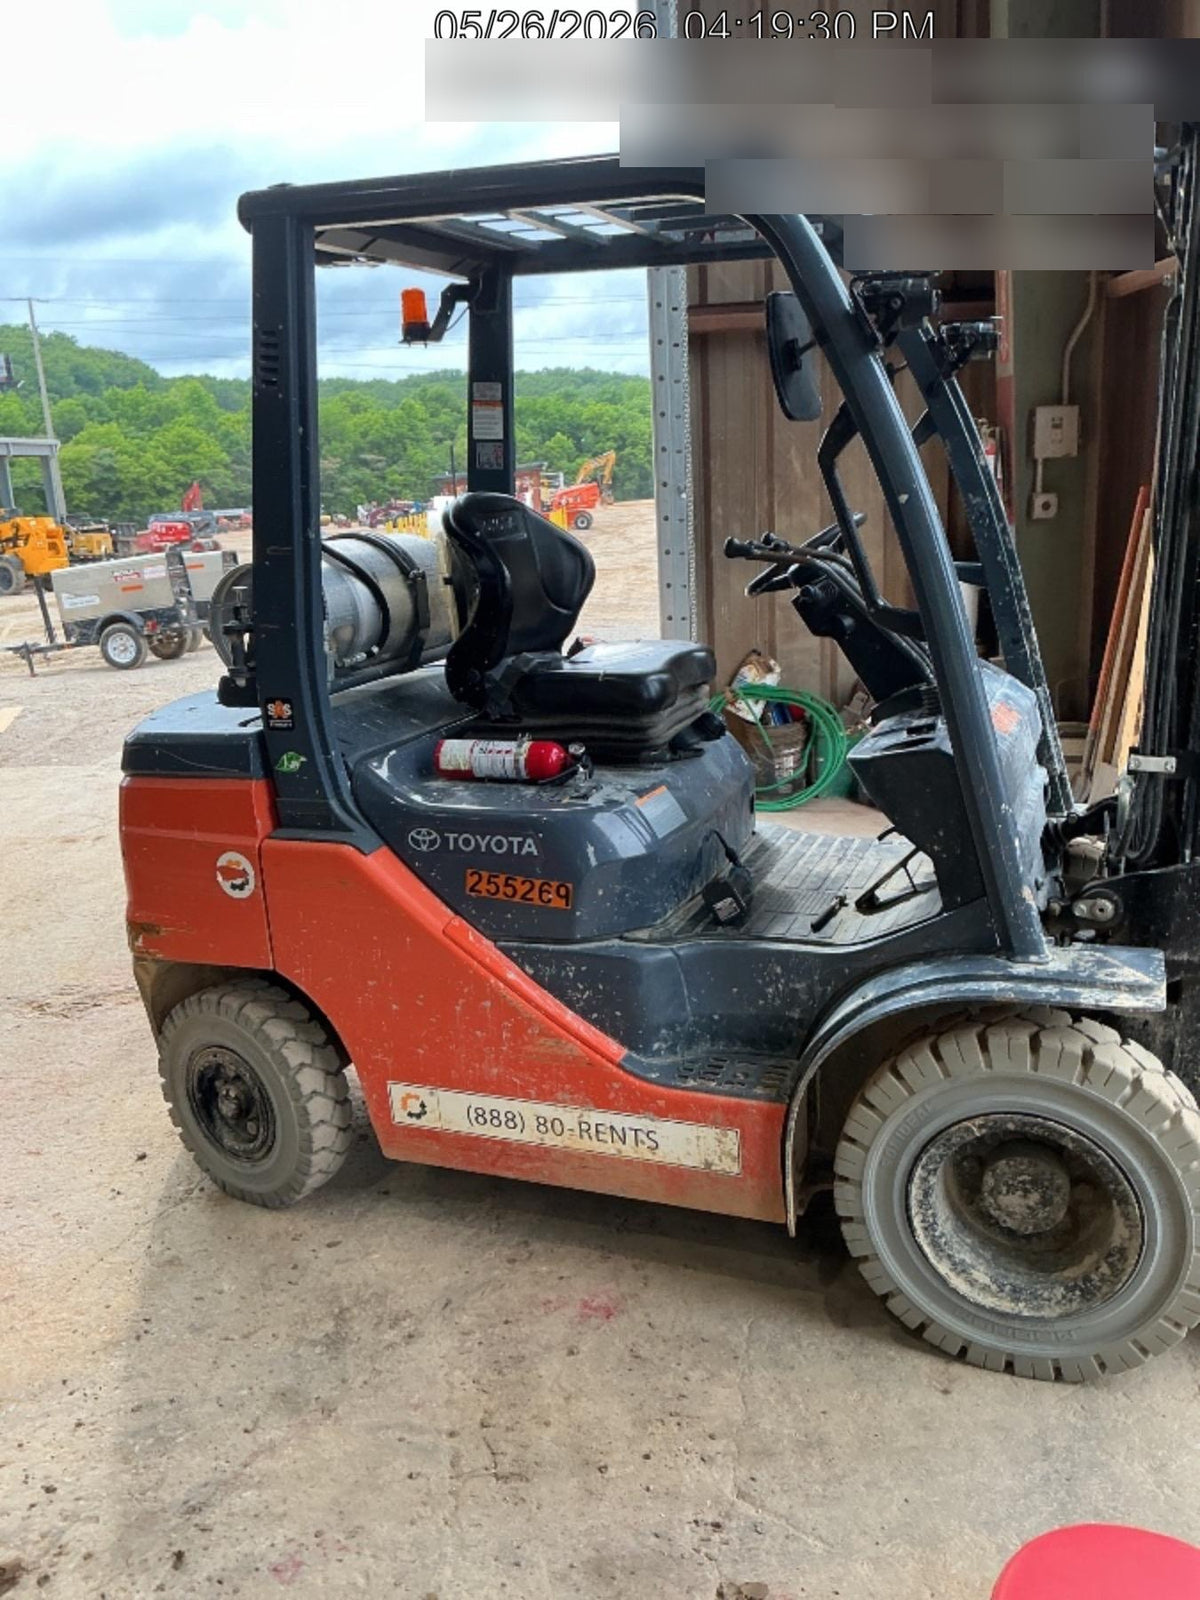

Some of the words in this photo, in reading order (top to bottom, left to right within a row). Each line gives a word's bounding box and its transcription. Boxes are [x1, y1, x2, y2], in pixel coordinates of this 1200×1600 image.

[444, 833, 538, 856] TOYOTA
[467, 870, 571, 908] 255269
[466, 1104, 526, 1134] (888)
[535, 1114, 660, 1151] 80-RENTS
